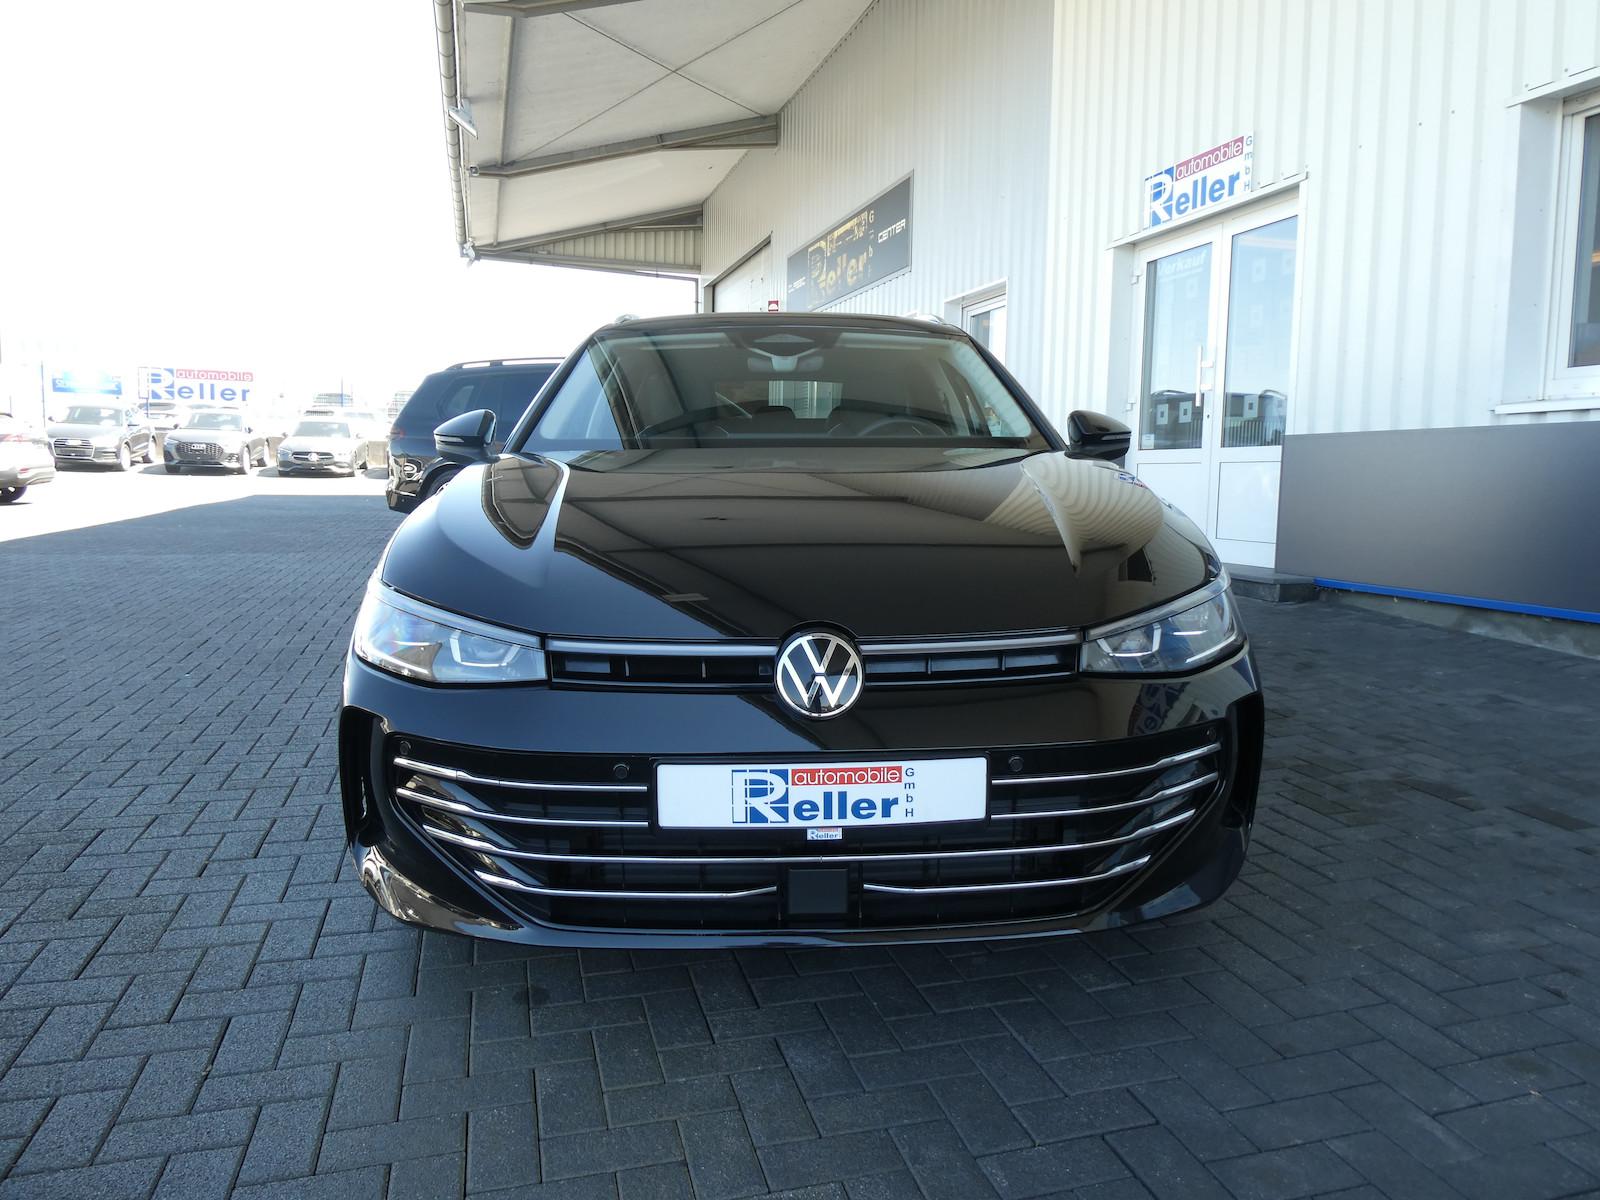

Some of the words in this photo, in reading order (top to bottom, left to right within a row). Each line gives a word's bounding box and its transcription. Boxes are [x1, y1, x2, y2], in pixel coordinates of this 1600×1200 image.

[1176, 141, 1243, 179] automobile
[1143, 167, 1240, 229] Reller
[877, 218, 906, 243] CENTER
[138, 367, 250, 400] Reller
[176, 369, 252, 382] automobile
[794, 768, 900, 785] automobile
[904, 767, 915, 817] GmbH
[731, 769, 899, 823] Reller
